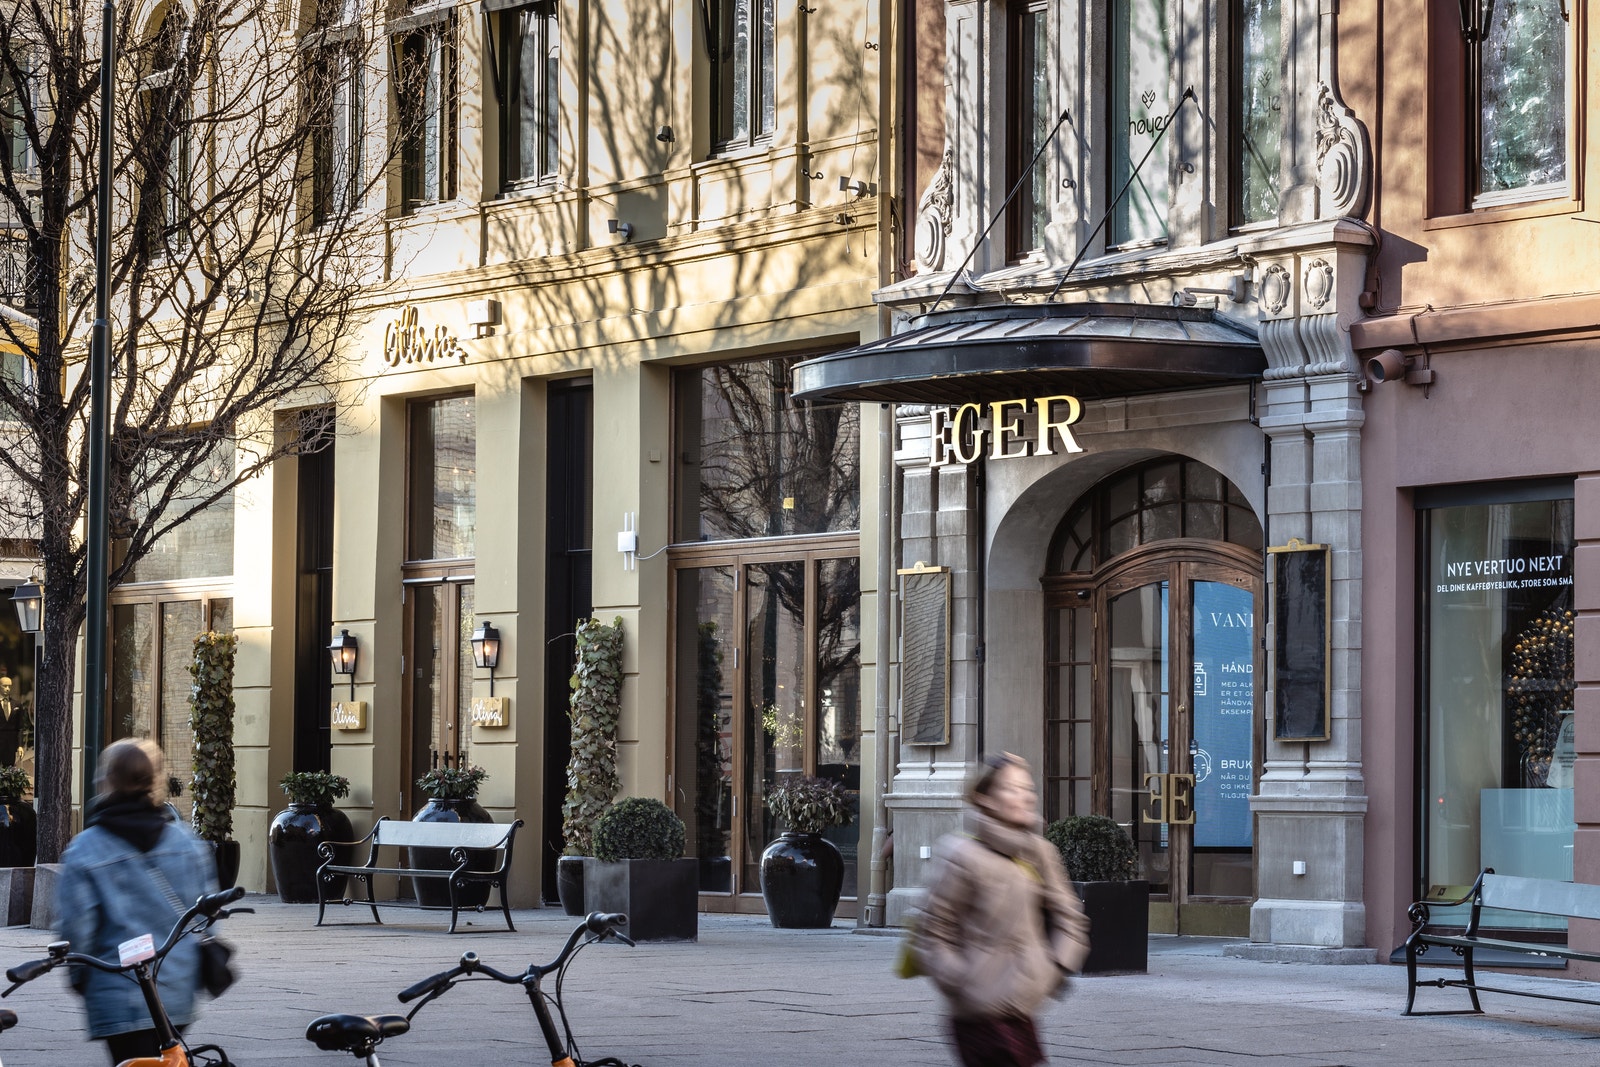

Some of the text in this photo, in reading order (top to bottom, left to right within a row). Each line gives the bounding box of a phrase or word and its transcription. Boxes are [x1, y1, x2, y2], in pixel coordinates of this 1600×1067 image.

[929, 394, 1084, 468] EGER
[1447, 555, 1563, 577] NYE VERTUO NEXT
[1436, 584, 1449, 593] DEL
[1450, 582, 1465, 592] DINE
[1520, 577, 1541, 588] STORE
[1542, 576, 1557, 587] SOM
[1558, 575, 1573, 585] SMÅ
[1221, 661, 1254, 673] HÅND
[1220, 697, 1253, 706] HÅNDVA
[332, 703, 360, 728] Olivia
[472, 698, 503, 724] Olivia
[1221, 759, 1252, 769] BRUK
[1220, 772, 1236, 780] NÅR
